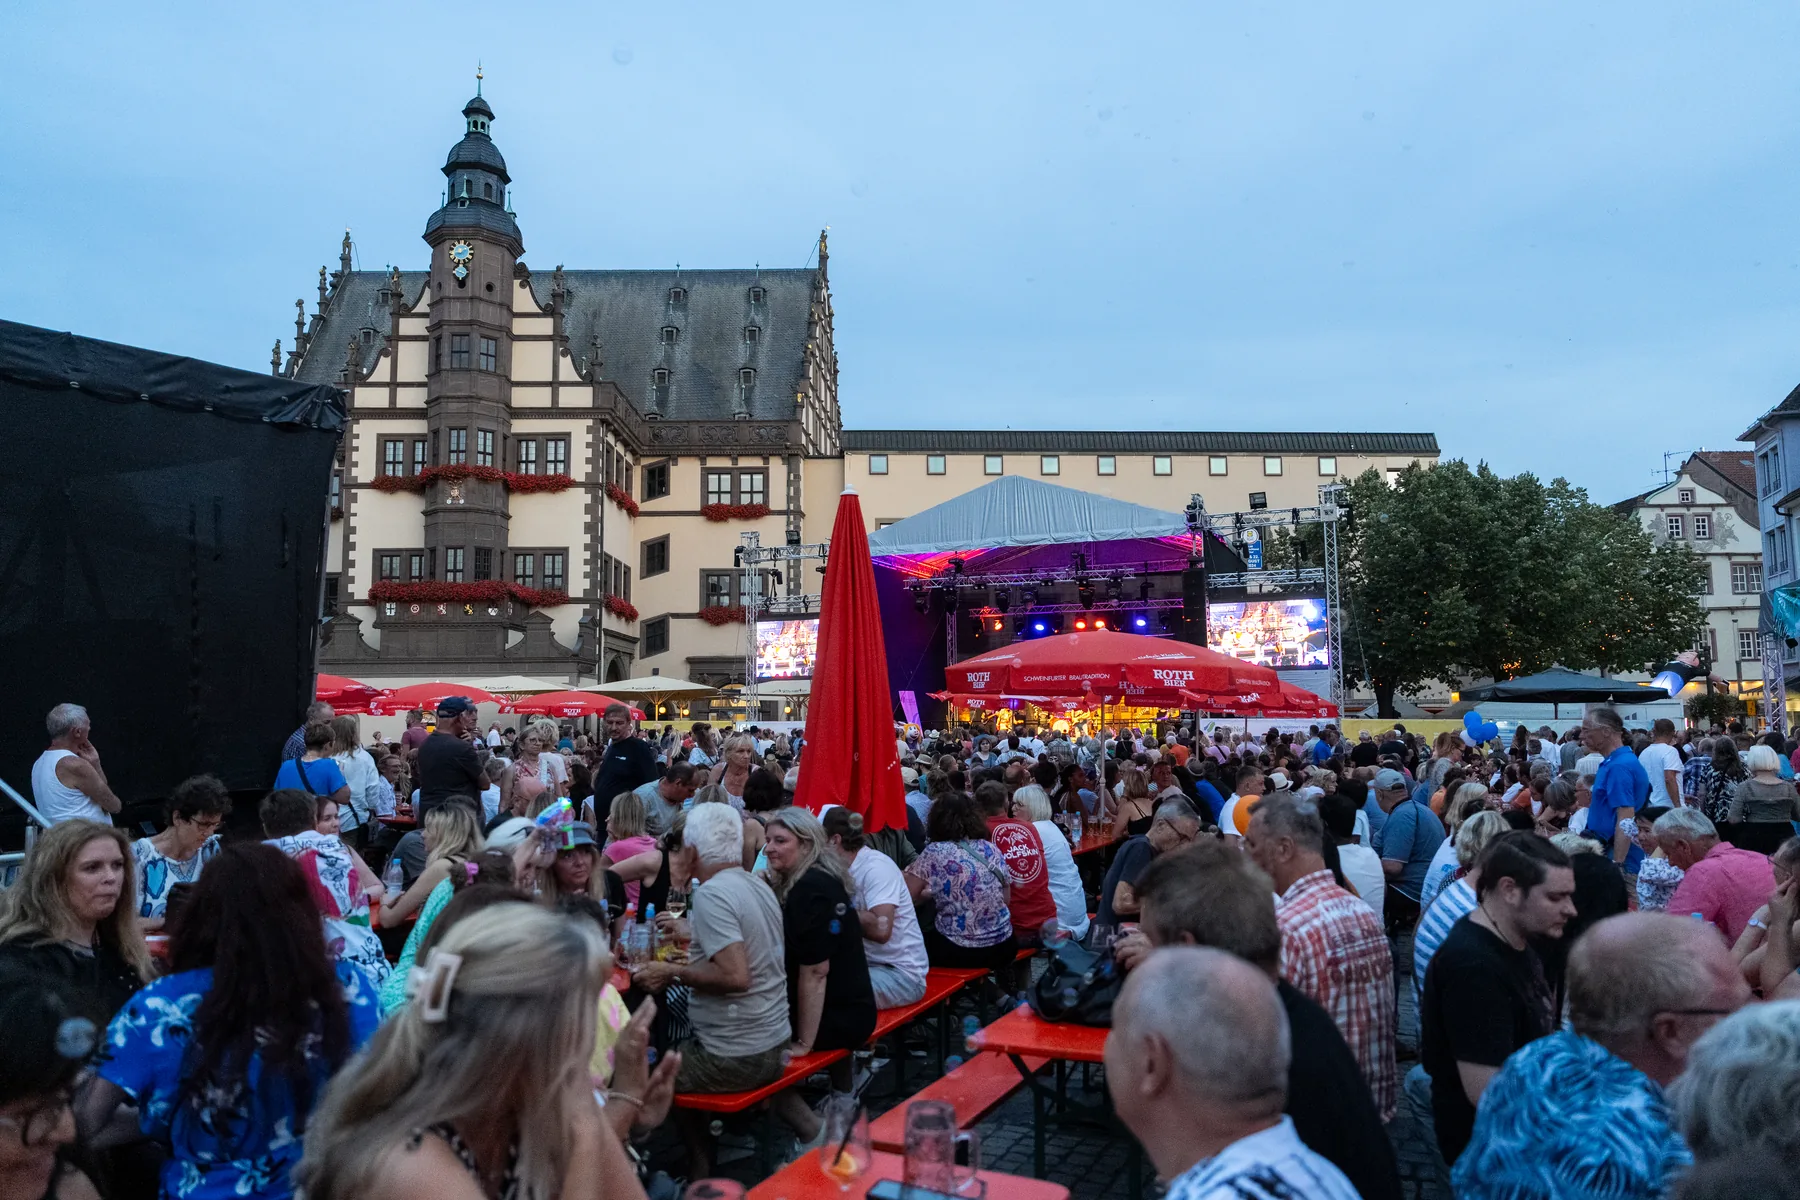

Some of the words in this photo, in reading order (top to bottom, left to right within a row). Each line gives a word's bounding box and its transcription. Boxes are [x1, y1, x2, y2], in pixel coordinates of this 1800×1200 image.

[966, 672, 990, 682] ROTH
[1023, 674, 1066, 682] SCHWEINFURTER
[1069, 673, 1110, 681] BRAUTRADITION
[1153, 669, 1195, 680] ROTH
[1008, 844, 1029, 853] JACK
